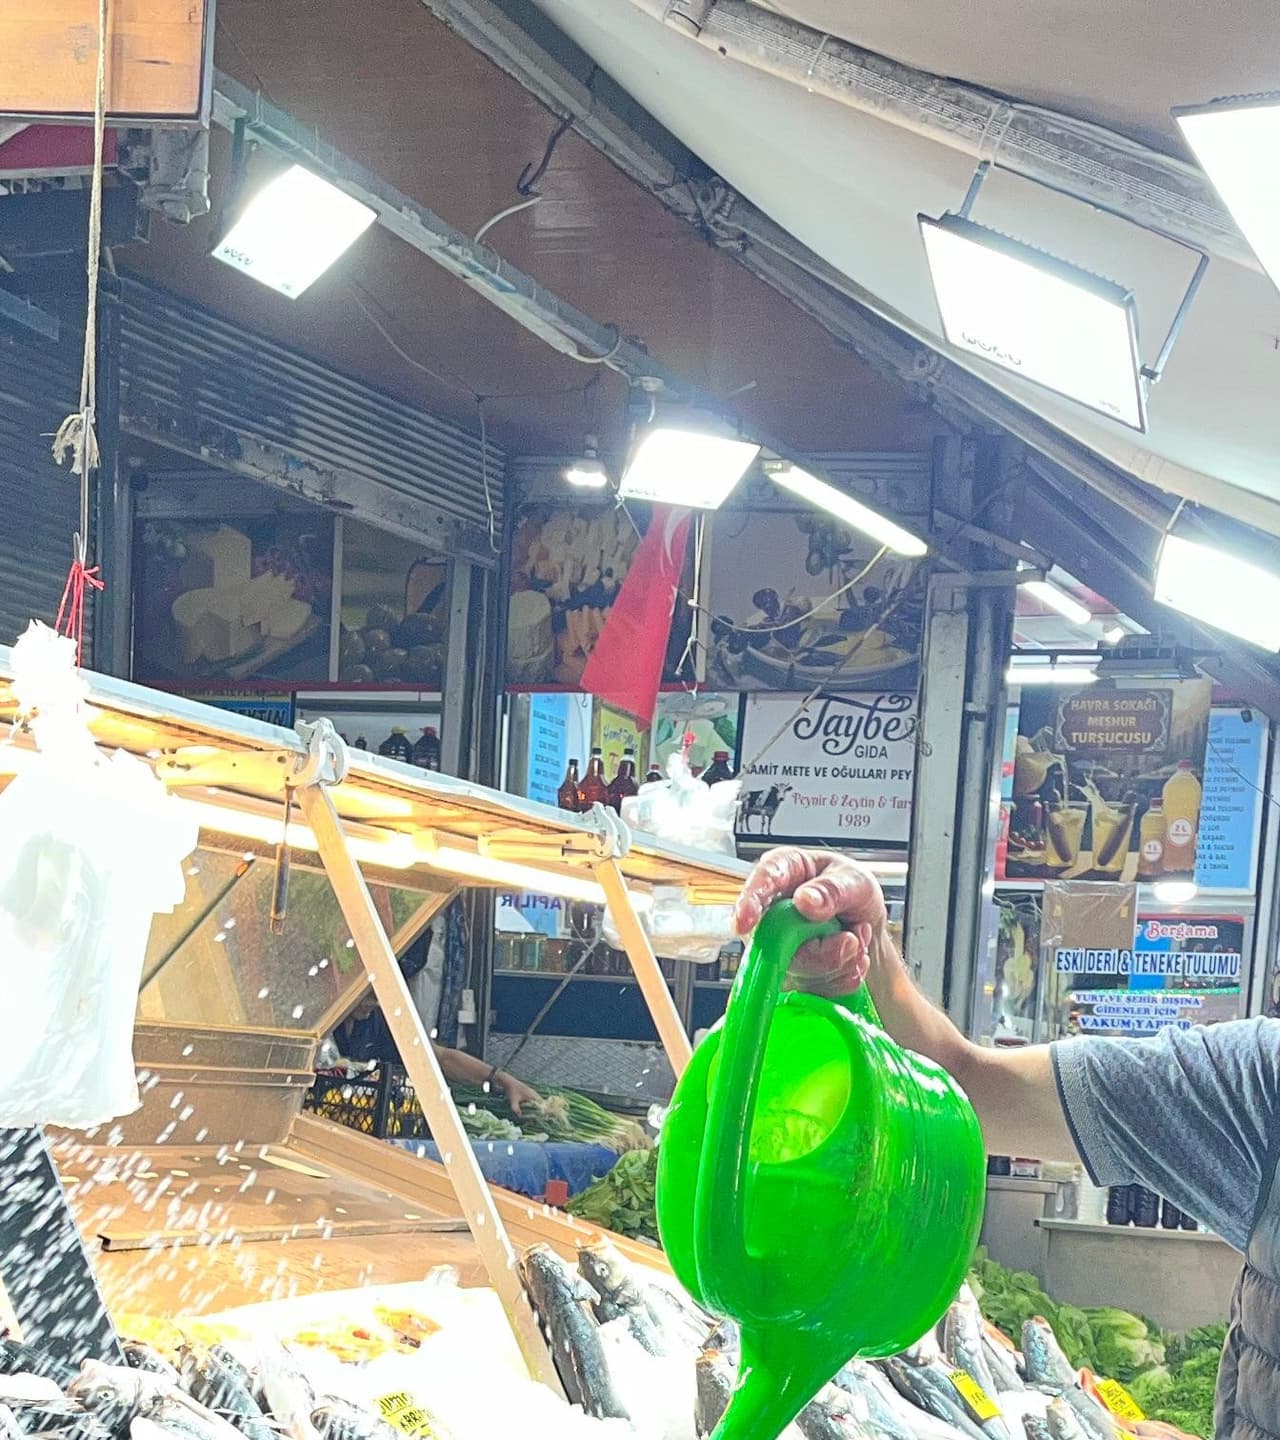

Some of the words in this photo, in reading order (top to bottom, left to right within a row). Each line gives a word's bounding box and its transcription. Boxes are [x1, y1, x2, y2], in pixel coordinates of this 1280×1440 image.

[793, 692, 916, 756] Taybe
[1071, 731, 1152, 746] TURŞUCUSU
[854, 744, 888, 759] GIDA
[781, 765, 810, 777] METE
[815, 766, 827, 777] VE
[832, 764, 886, 780] OĞULLARI
[890, 769, 912, 780] PEY
[841, 794, 875, 809] Zeytin
[889, 797, 912, 809] Tur
[838, 813, 870, 827] 1989
[1148, 922, 1218, 939] Bergama
[1056, 949, 1083, 971] ESKİ
[1087, 949, 1116, 972] DERİ
[1120, 954, 1131, 972] &
[1135, 954, 1181, 973] TENEKE
[1186, 955, 1238, 975] TULUMU
[1096, 1005, 1150, 1015] GİDENLER
[1081, 1017, 1131, 1029] VAKUM
